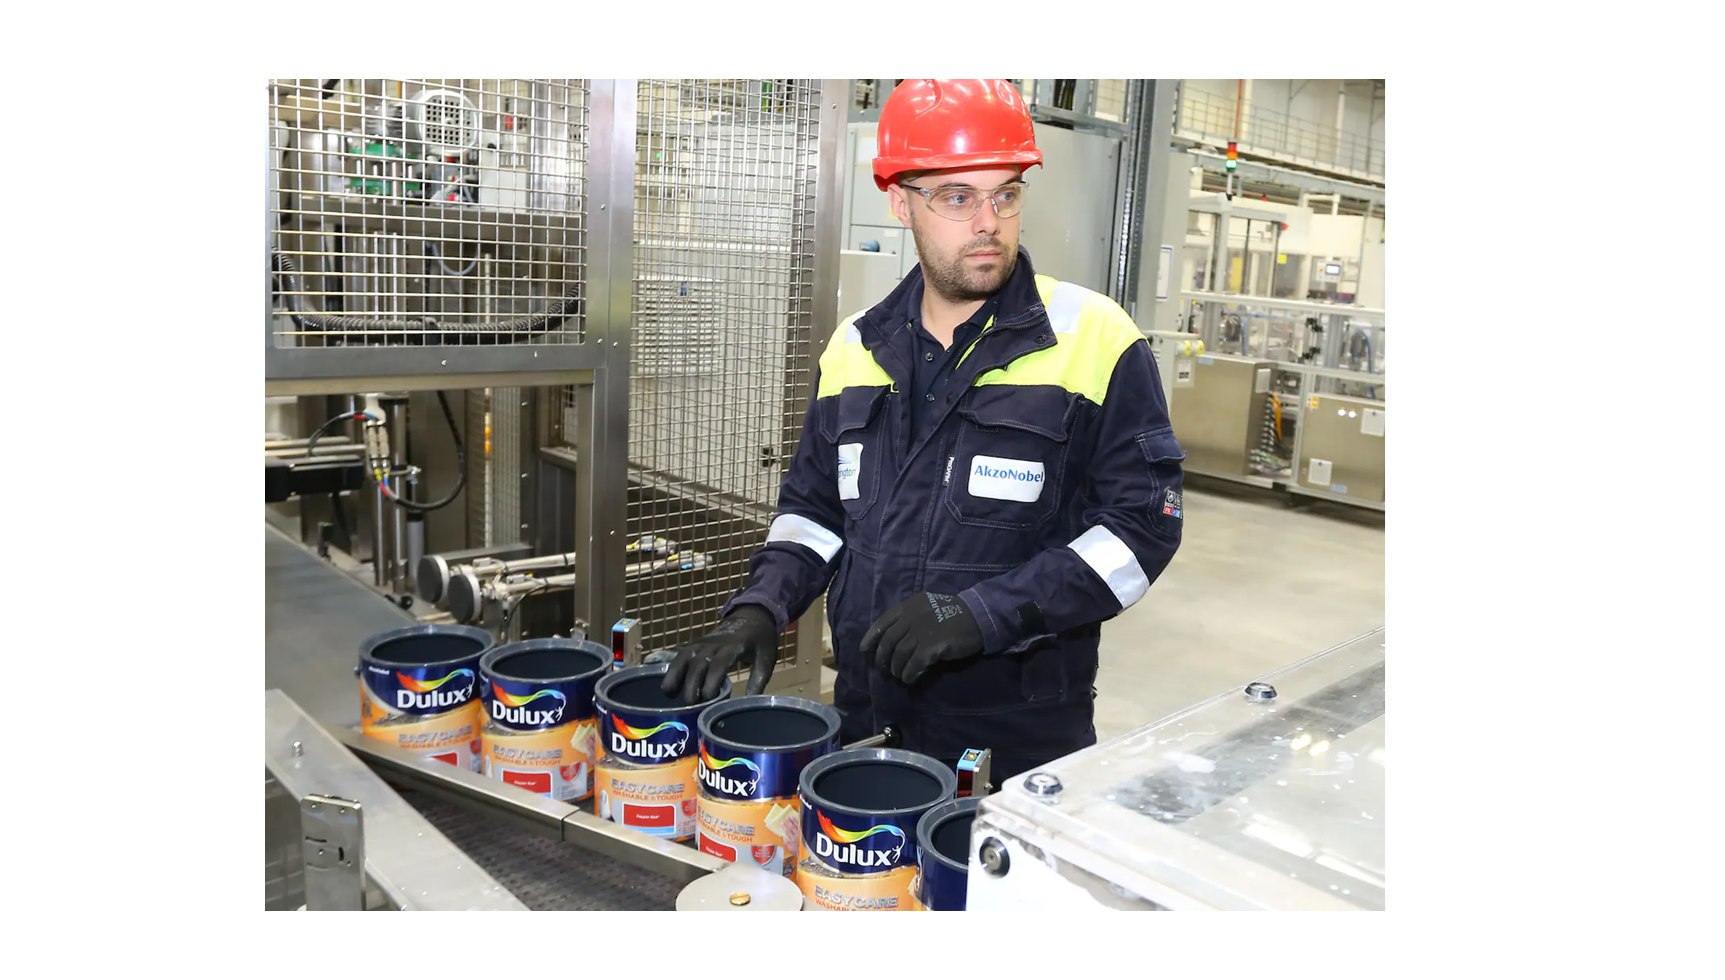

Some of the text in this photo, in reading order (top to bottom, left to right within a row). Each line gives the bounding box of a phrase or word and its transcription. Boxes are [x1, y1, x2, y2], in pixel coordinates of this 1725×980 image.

[974, 464, 1044, 483] AkzoNobel
[397, 688, 467, 709] Dulux
[492, 699, 555, 725] Dulux
[398, 725, 473, 743] EASYCARE
[493, 744, 563, 759] EASYCARE
[611, 732, 678, 758] Dulux
[611, 778, 685, 795] EASYCARE
[698, 757, 748, 797] Dulux
[613, 790, 649, 801] WASHABLE
[727, 831, 753, 843] TOUGH
[815, 831, 892, 867] Dulux
[815, 885, 899, 909] EASYCARE
